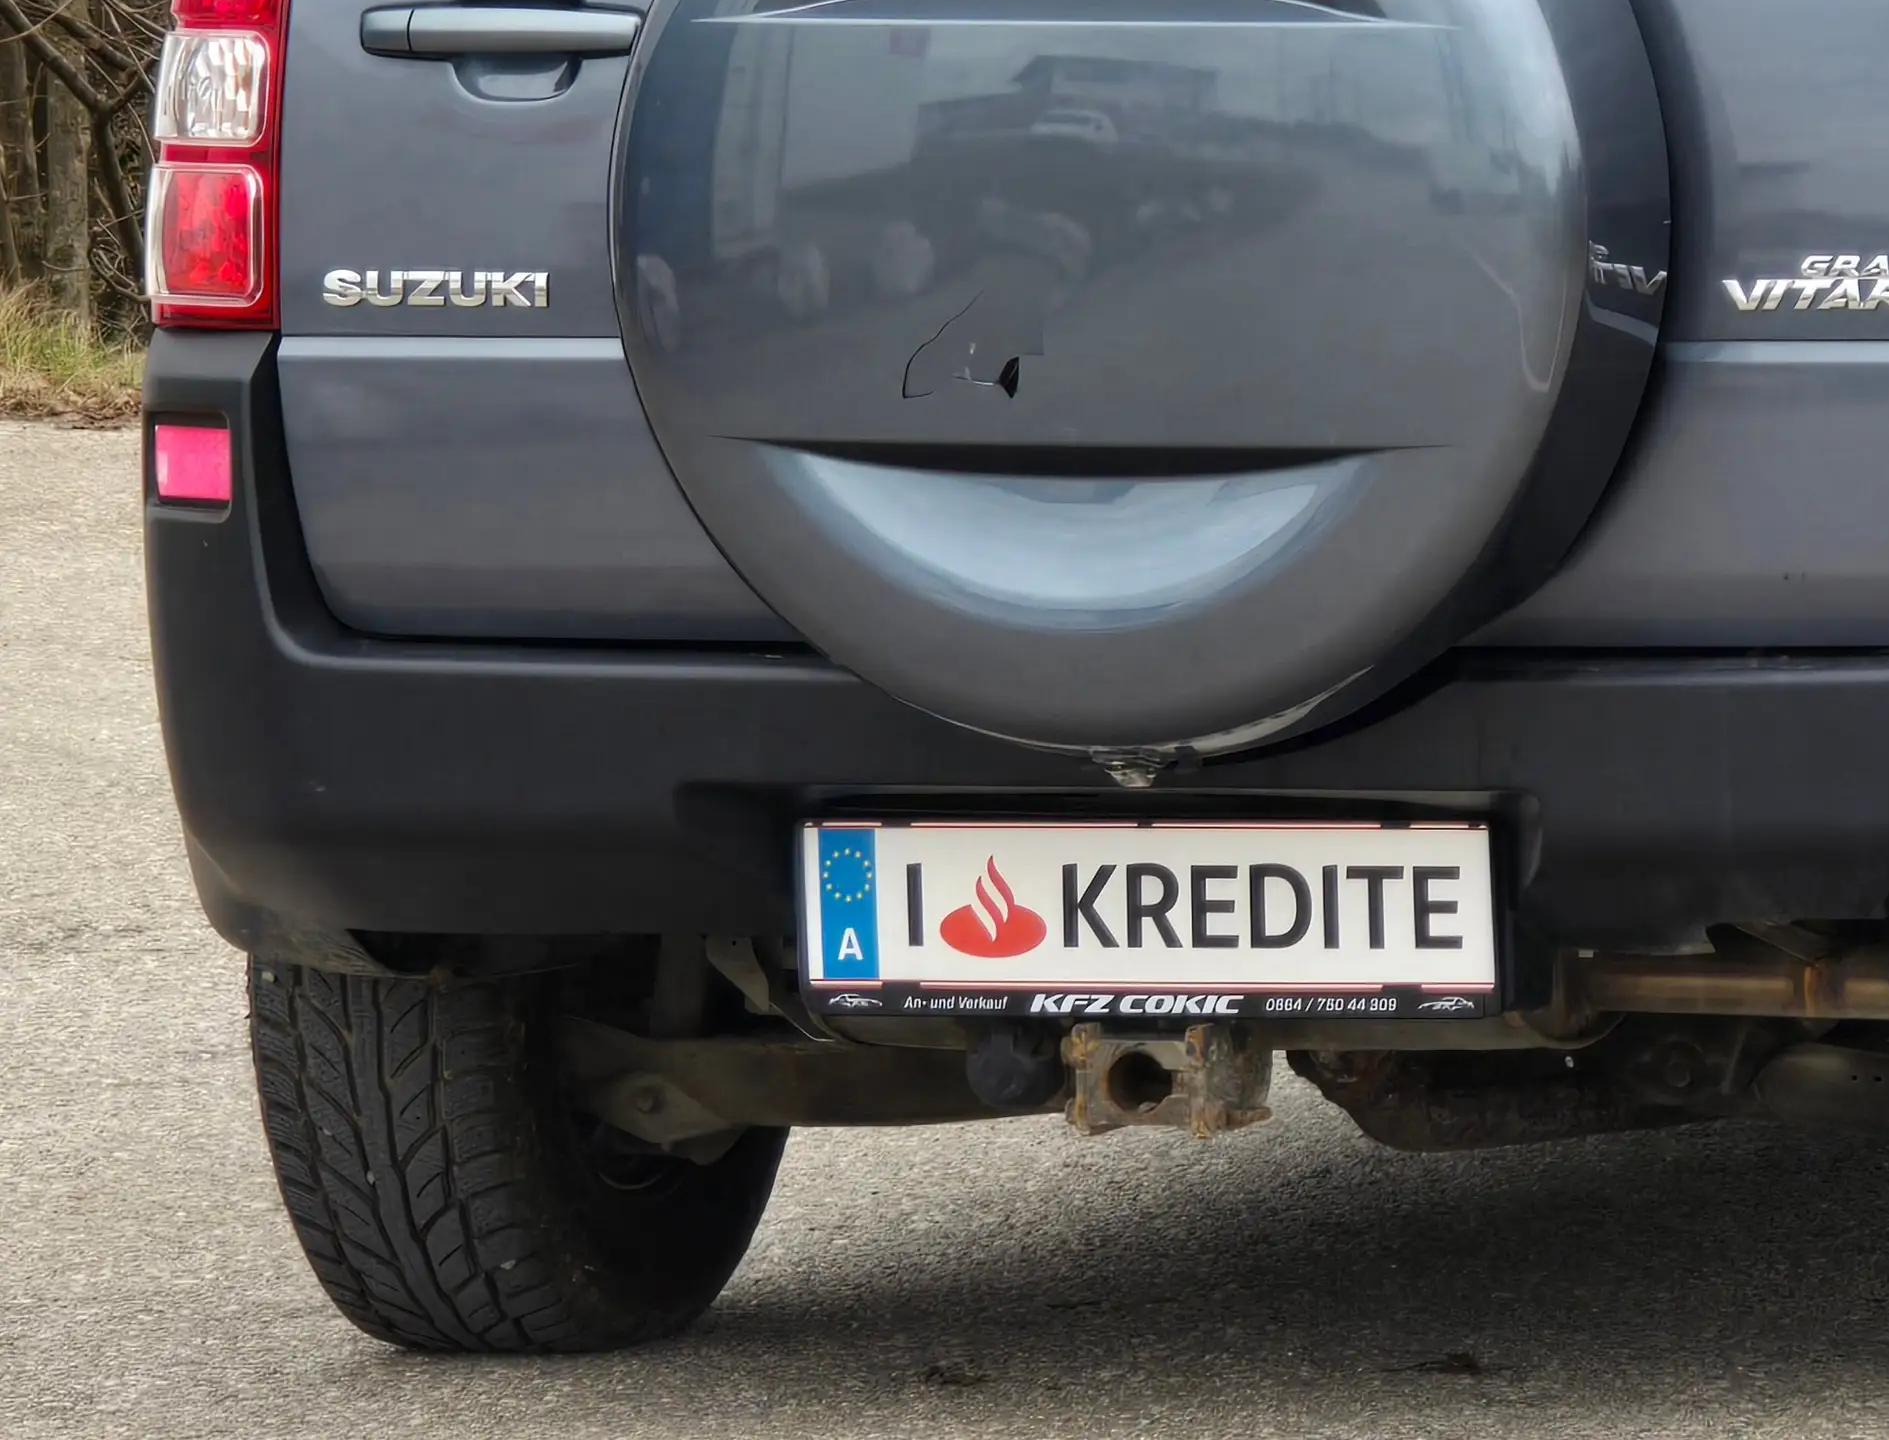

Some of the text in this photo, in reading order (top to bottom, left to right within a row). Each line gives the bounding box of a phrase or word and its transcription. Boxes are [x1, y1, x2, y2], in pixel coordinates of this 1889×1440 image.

[322, 269, 550, 308] SUZUKI
[906, 863, 1463, 950] I KREDITE
[837, 927, 863, 960] A
[930, 995, 955, 1010] und
[959, 995, 1008, 1010] Verkauf
[1030, 993, 1245, 1014] KFZ COKIC
